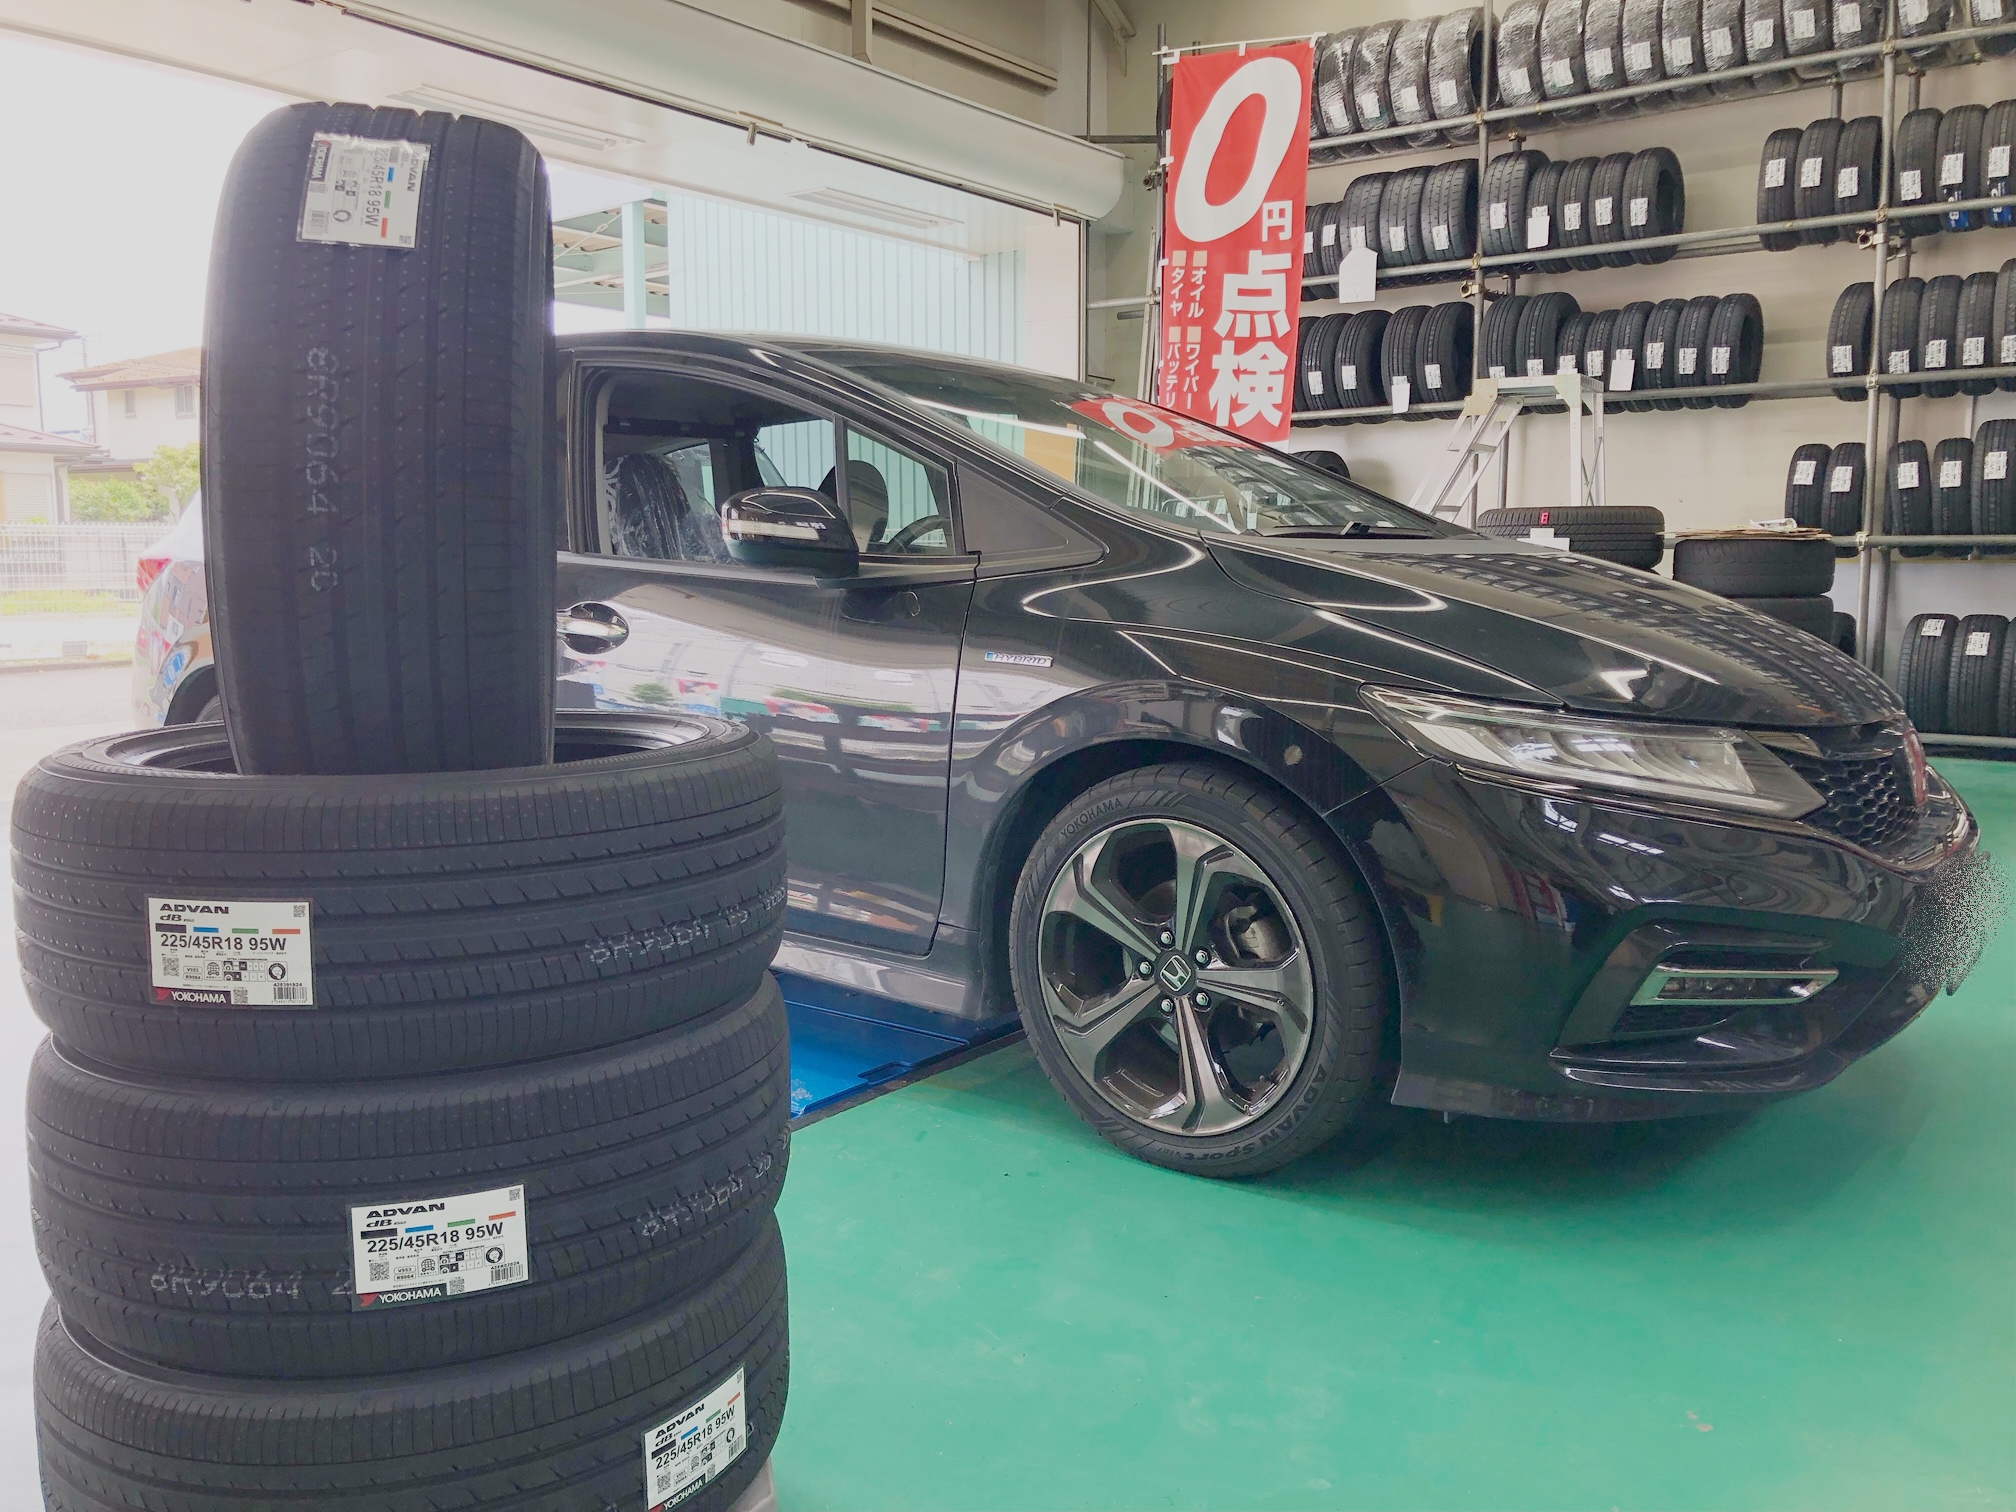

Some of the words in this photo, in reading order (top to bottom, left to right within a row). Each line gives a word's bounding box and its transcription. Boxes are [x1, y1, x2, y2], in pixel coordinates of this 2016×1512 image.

[367, 147, 390, 197] 225/45R18
[406, 150, 421, 192] ADVAN
[365, 200, 381, 227] 95W
[1170, 267, 1185, 317] タイヤ
[1187, 268, 1207, 319] オイル
[1208, 250, 1292, 428] 点検
[1183, 343, 1201, 410] ワイパー
[994, 652, 1047, 665] HYBRID
[1060, 797, 1123, 839] YOKOHAMA
[159, 903, 229, 914] ADVAN
[159, 914, 182, 922] dB
[160, 933, 244, 951] 225/45R18
[249, 937, 287, 951] 95W
[171, 990, 227, 1004] YOKOHAMA
[1259, 1063, 1328, 1148] ADVAN
[366, 1202, 445, 1219] ADVAN
[366, 1219, 392, 1228] dB
[366, 1230, 460, 1253] 225/45R18
[465, 1222, 504, 1241] 95W
[379, 1287, 442, 1304] YOKOHAMA
[655, 1403, 705, 1440] ADVAN
[655, 1423, 713, 1470] 225/45R18
[715, 1404, 735, 1429] 95W
[655, 1433, 673, 1448] dB
[663, 1479, 703, 1511] YOKOHAMA
